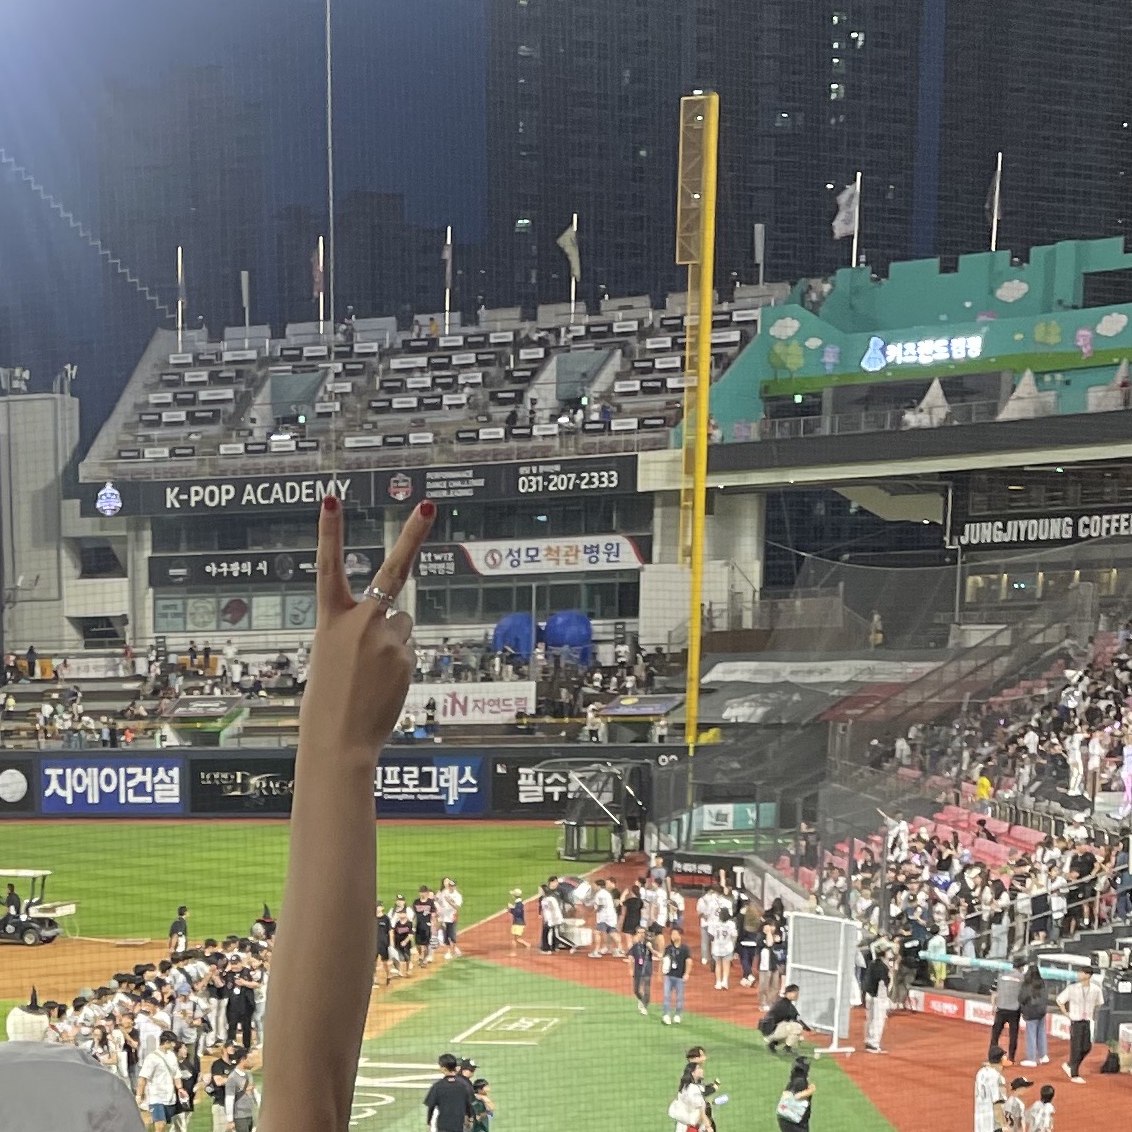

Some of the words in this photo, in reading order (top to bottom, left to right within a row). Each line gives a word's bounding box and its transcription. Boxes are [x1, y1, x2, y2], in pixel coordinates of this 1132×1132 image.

[886, 339, 949, 364] 키즈랜드
[166, 484, 236, 508] K-POP
[241, 479, 351, 506] ACADEMY
[960, 517, 1074, 545] JUNGJIYOUNG
[473, 697, 528, 715] 자연드림
[44, 766, 181, 804] 지에이건설
